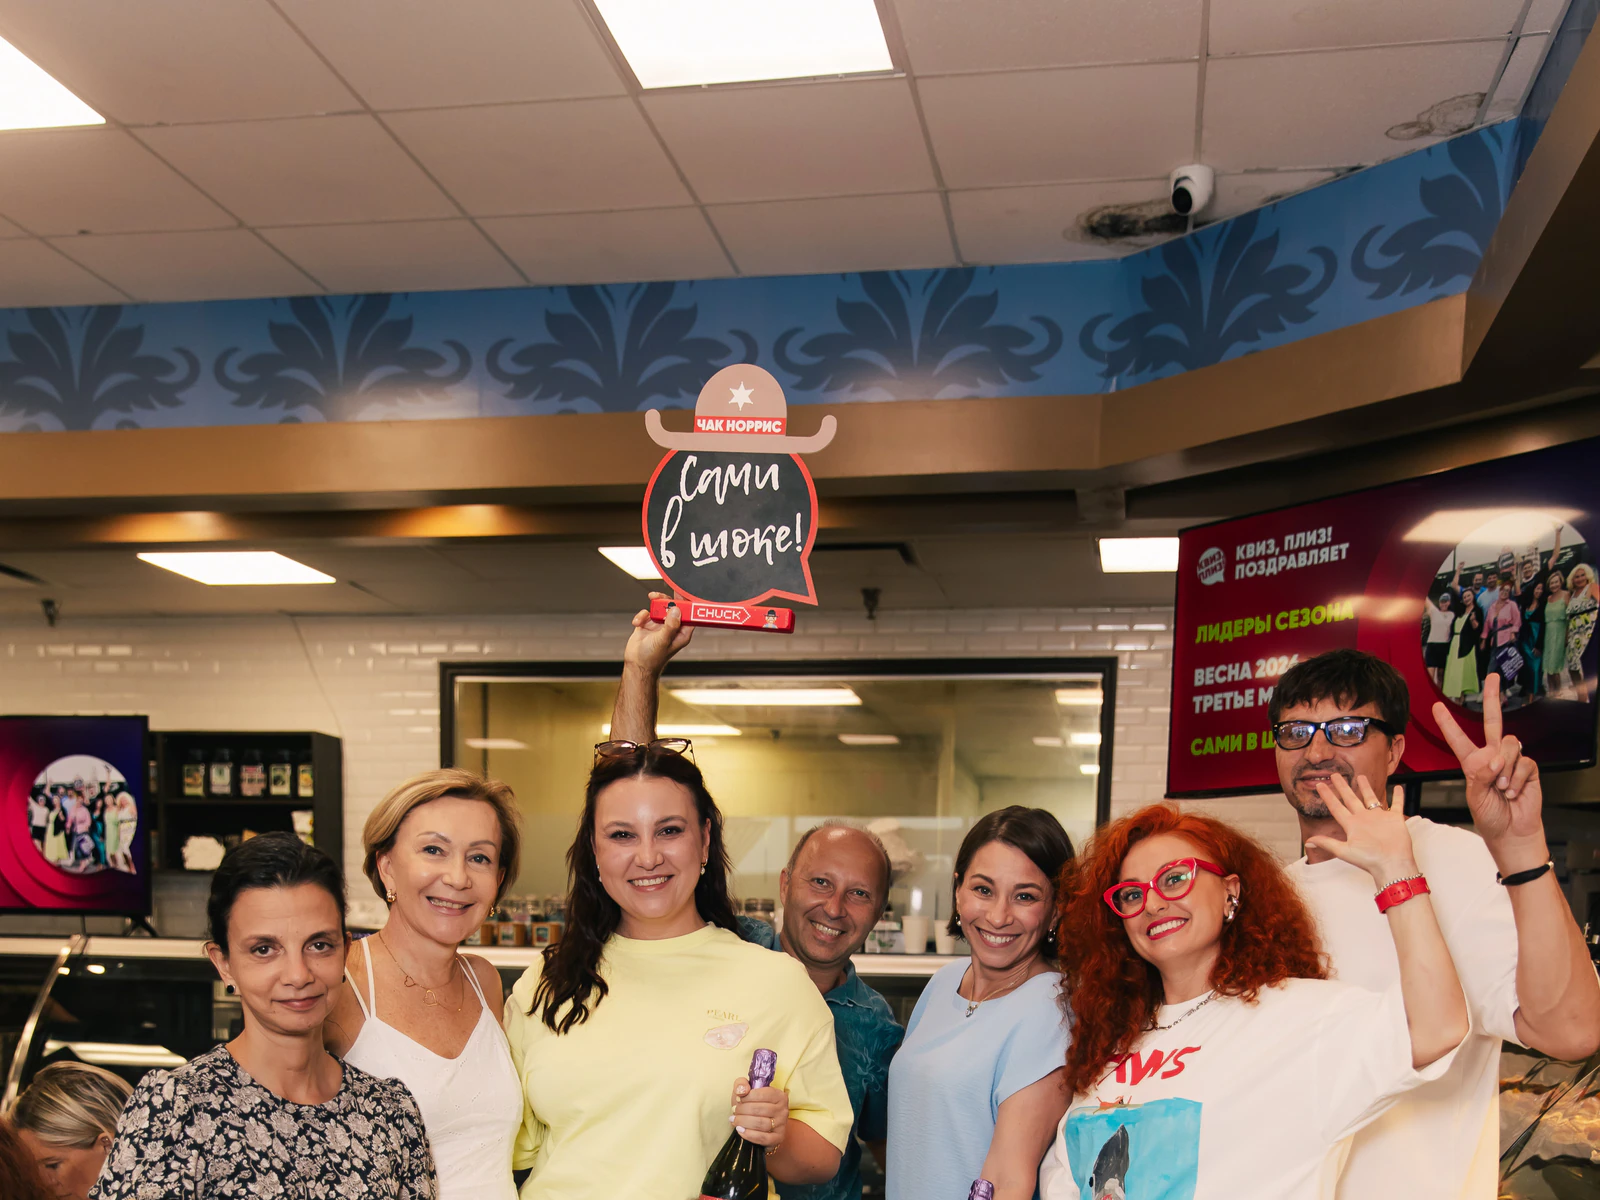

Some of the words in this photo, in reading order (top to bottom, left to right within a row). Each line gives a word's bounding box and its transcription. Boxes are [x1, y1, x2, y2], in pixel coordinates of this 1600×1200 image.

[697, 418, 723, 431] ЧАК
[726, 419, 782, 434] НОРРИС
[679, 455, 780, 505] Сами
[1236, 538, 1280, 561] КВИЗ,
[1284, 526, 1333, 551] ПЛИЗ!
[1235, 542, 1350, 581] ПОЗДРАВЛЯЕТ
[697, 607, 742, 621] CHUCK
[1195, 614, 1271, 644] ЛИДЕРЫ
[1275, 601, 1354, 631] СЕЗОНА
[1194, 661, 1252, 687] ВЕСНА
[1192, 688, 1255, 714] ТРЕТЬЕ
[1191, 734, 1242, 756] САМИ
[1246, 732, 1258, 751] В
[1097, 1045, 1201, 1086] AWS
